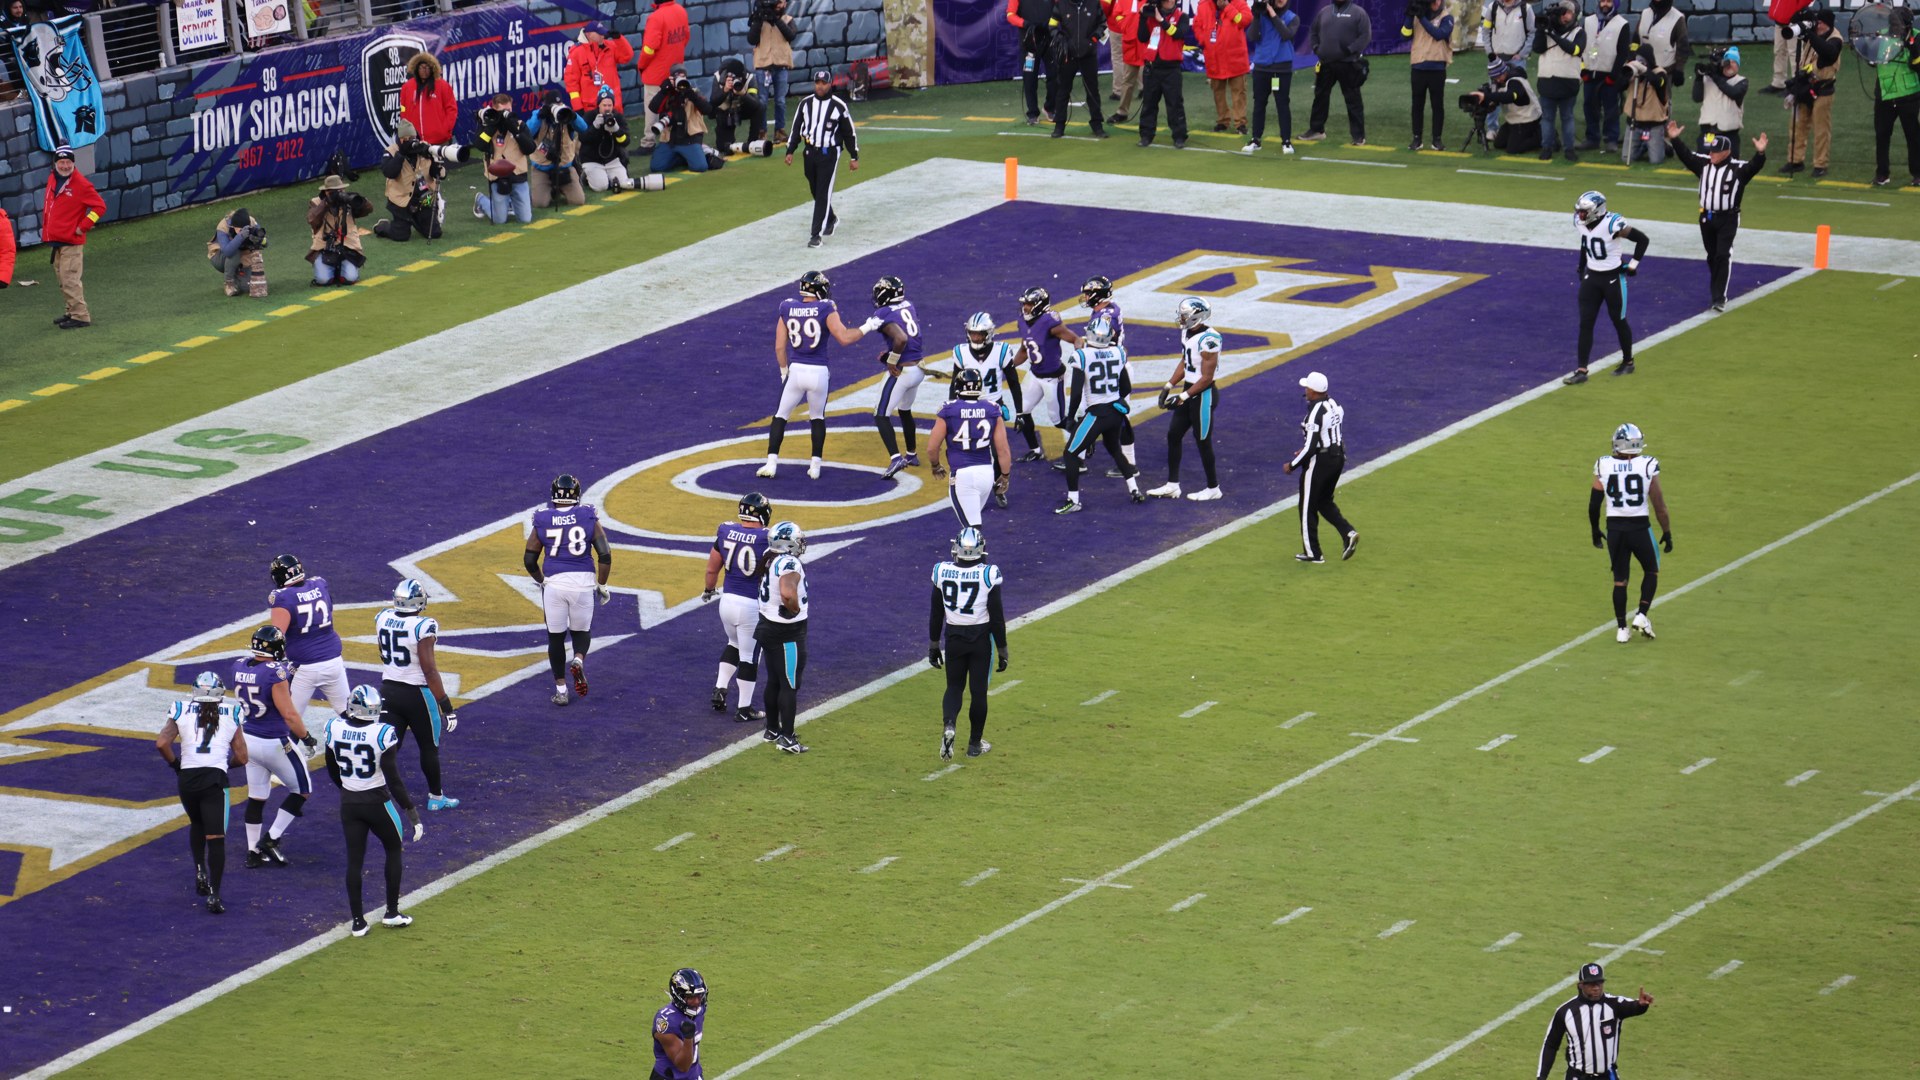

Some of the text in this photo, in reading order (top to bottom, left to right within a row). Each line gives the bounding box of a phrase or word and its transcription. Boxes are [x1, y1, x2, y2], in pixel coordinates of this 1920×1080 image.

[196, 8, 214, 19] YOUR
[508, 20, 524, 46] 45
[388, 47, 401, 66] 98
[262, 66, 277, 93] 98
[384, 65, 408, 86] GOOSE
[190, 82, 351, 153] TONY SIRAGUSA
[237, 145, 264, 170] 1967
[275, 137, 304, 162] 2022
[788, 306, 819, 317] ANDREWS
[900, 308, 918, 338] 8
[786, 317, 822, 349] 89
[1088, 359, 1120, 395] 25
[960, 408, 986, 419] RICARD
[1330, 413, 1341, 427] 23
[952, 418, 992, 451] 42
[90, 427, 312, 480] US
[1606, 473, 1645, 508] 49
[552, 514, 577, 526] MOSES
[545, 525, 587, 557] 78
[726, 529, 758, 545] ZEITLER
[723, 539, 757, 577] 70
[296, 587, 323, 603] POWERS
[941, 580, 980, 615] 97
[296, 599, 332, 634] 72
[378, 627, 412, 668] 95
[234, 671, 257, 684] MEKARI
[234, 684, 268, 719] 65
[341, 729, 367, 742] BURNS
[333, 740, 377, 780] 53
